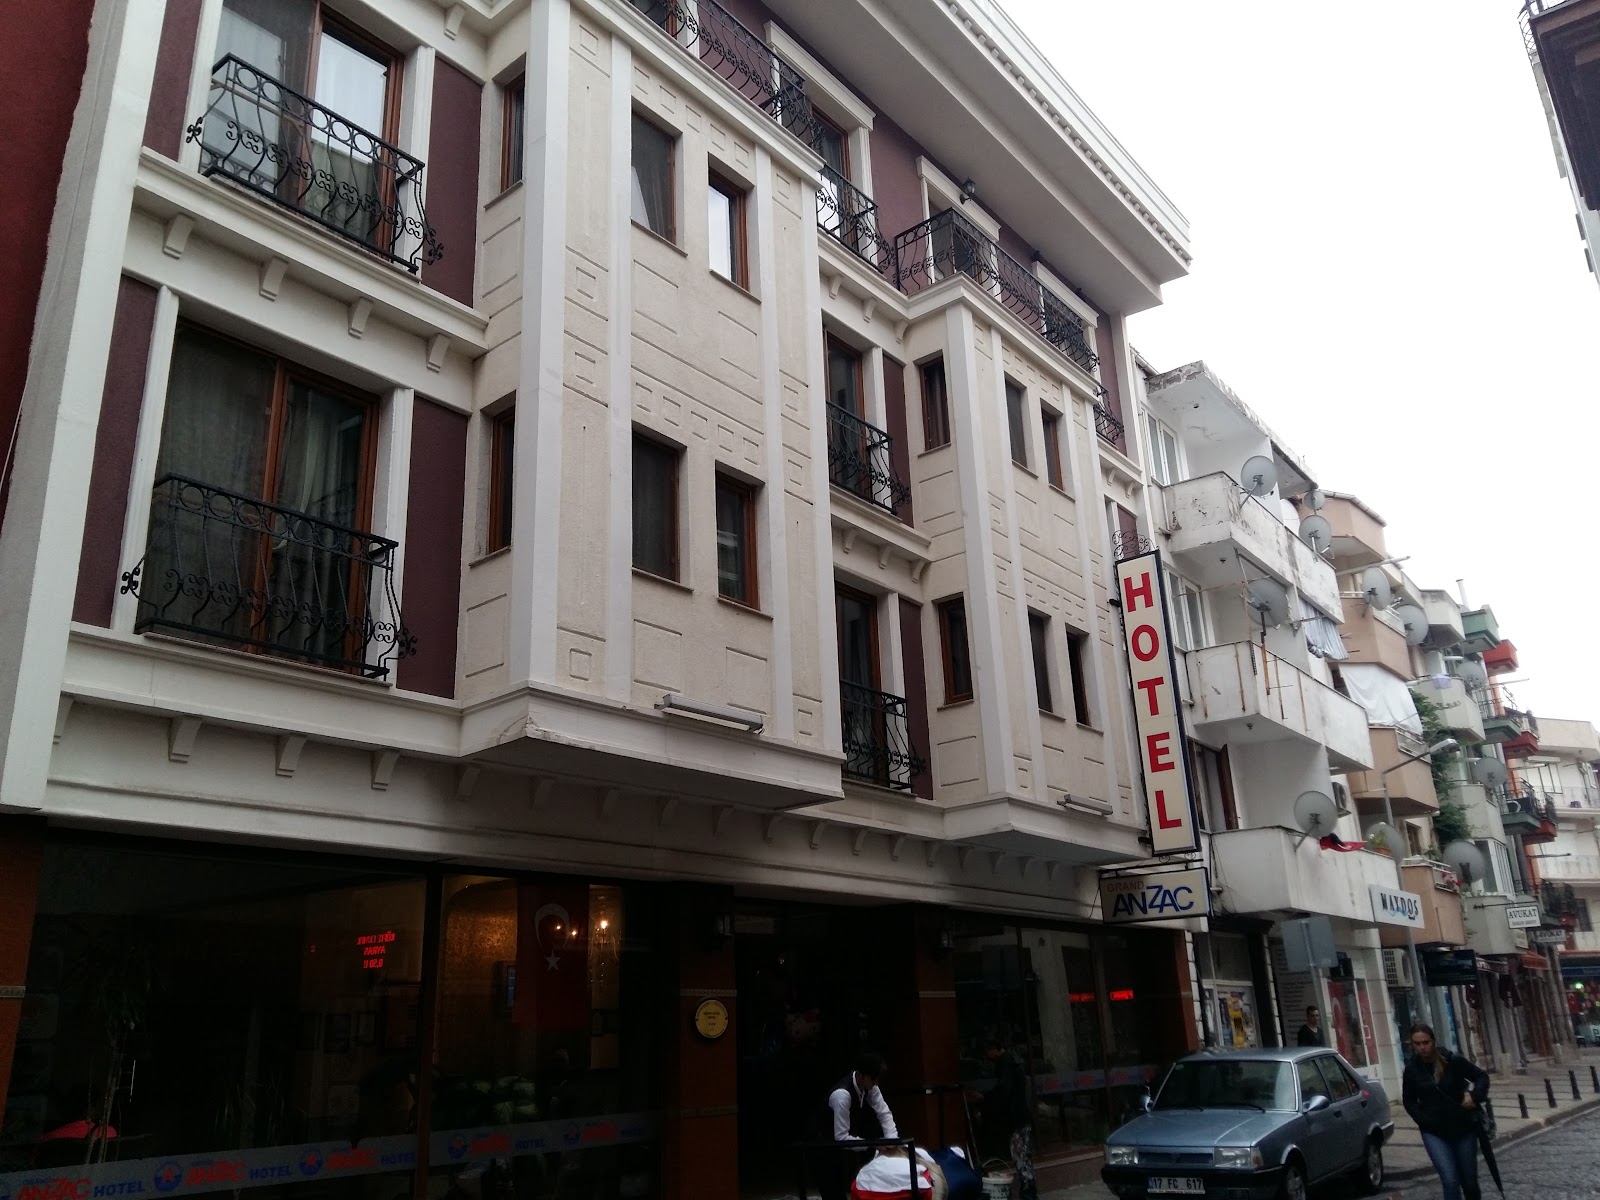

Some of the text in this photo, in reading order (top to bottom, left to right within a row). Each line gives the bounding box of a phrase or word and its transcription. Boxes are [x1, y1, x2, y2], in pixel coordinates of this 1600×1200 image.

[1123, 572, 1182, 830] HOTEL
[1107, 880, 1145, 892] GRAND
[1113, 885, 1194, 917] ANZAC
[1509, 909, 1537, 919] AVUKAT
[249, 1165, 293, 1180] HOTEL
[16, 1178, 146, 1200] ANZAC HOTEL
[1153, 1178, 1202, 1190] 17 FC 617
